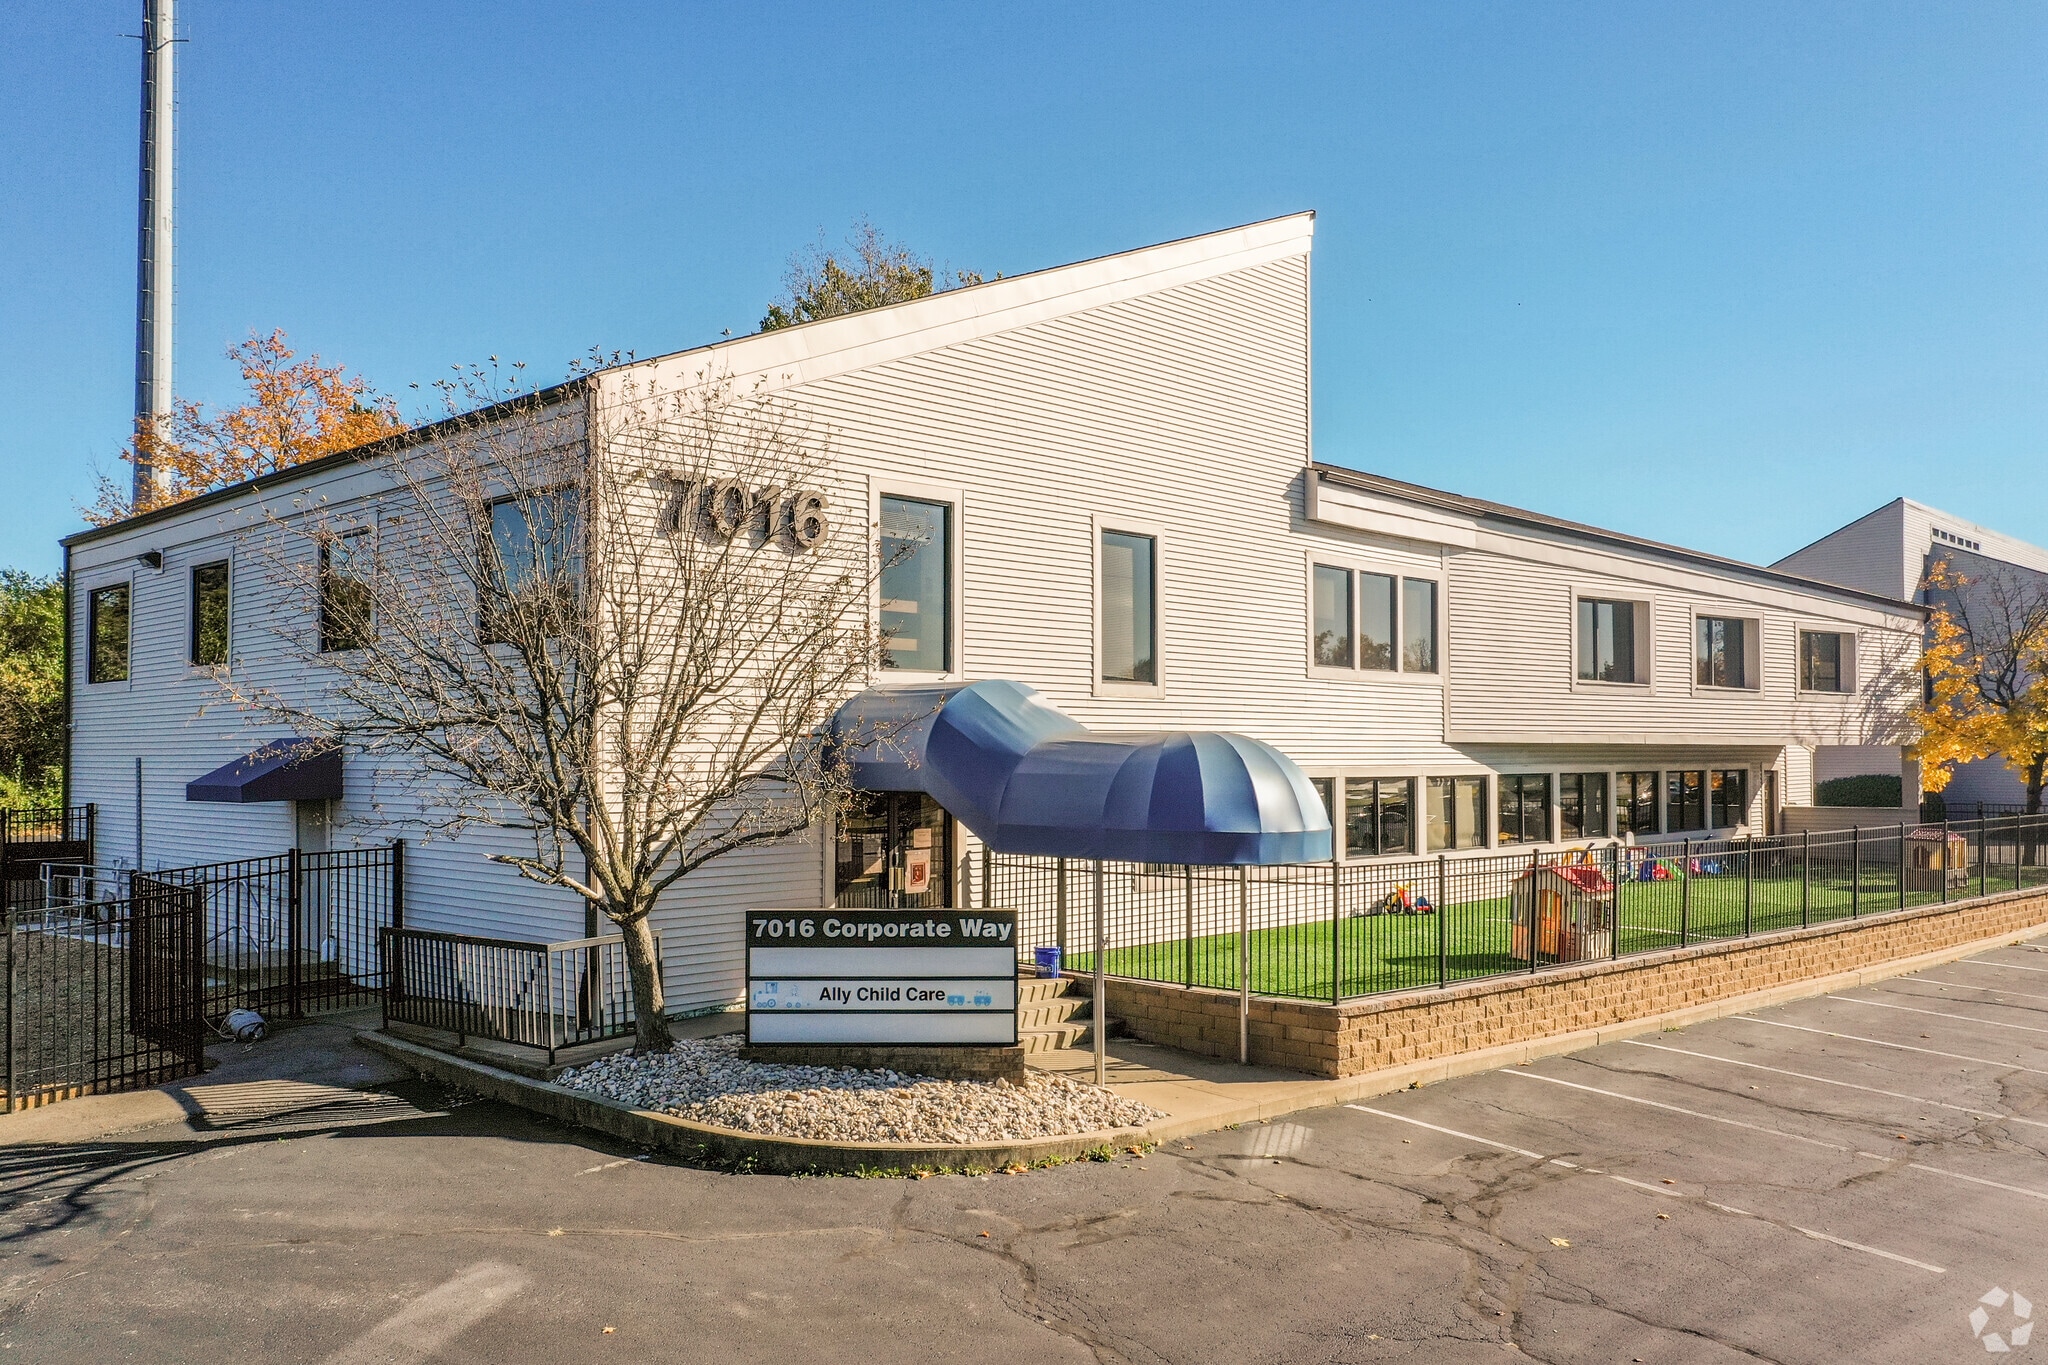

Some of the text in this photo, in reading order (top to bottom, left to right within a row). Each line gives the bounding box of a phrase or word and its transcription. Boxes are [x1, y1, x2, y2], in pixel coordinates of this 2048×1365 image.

[649, 469, 830, 556] 7016
[752, 918, 1012, 941] 7016 Corporate Way
[819, 986, 945, 1004] Ally Child Care
